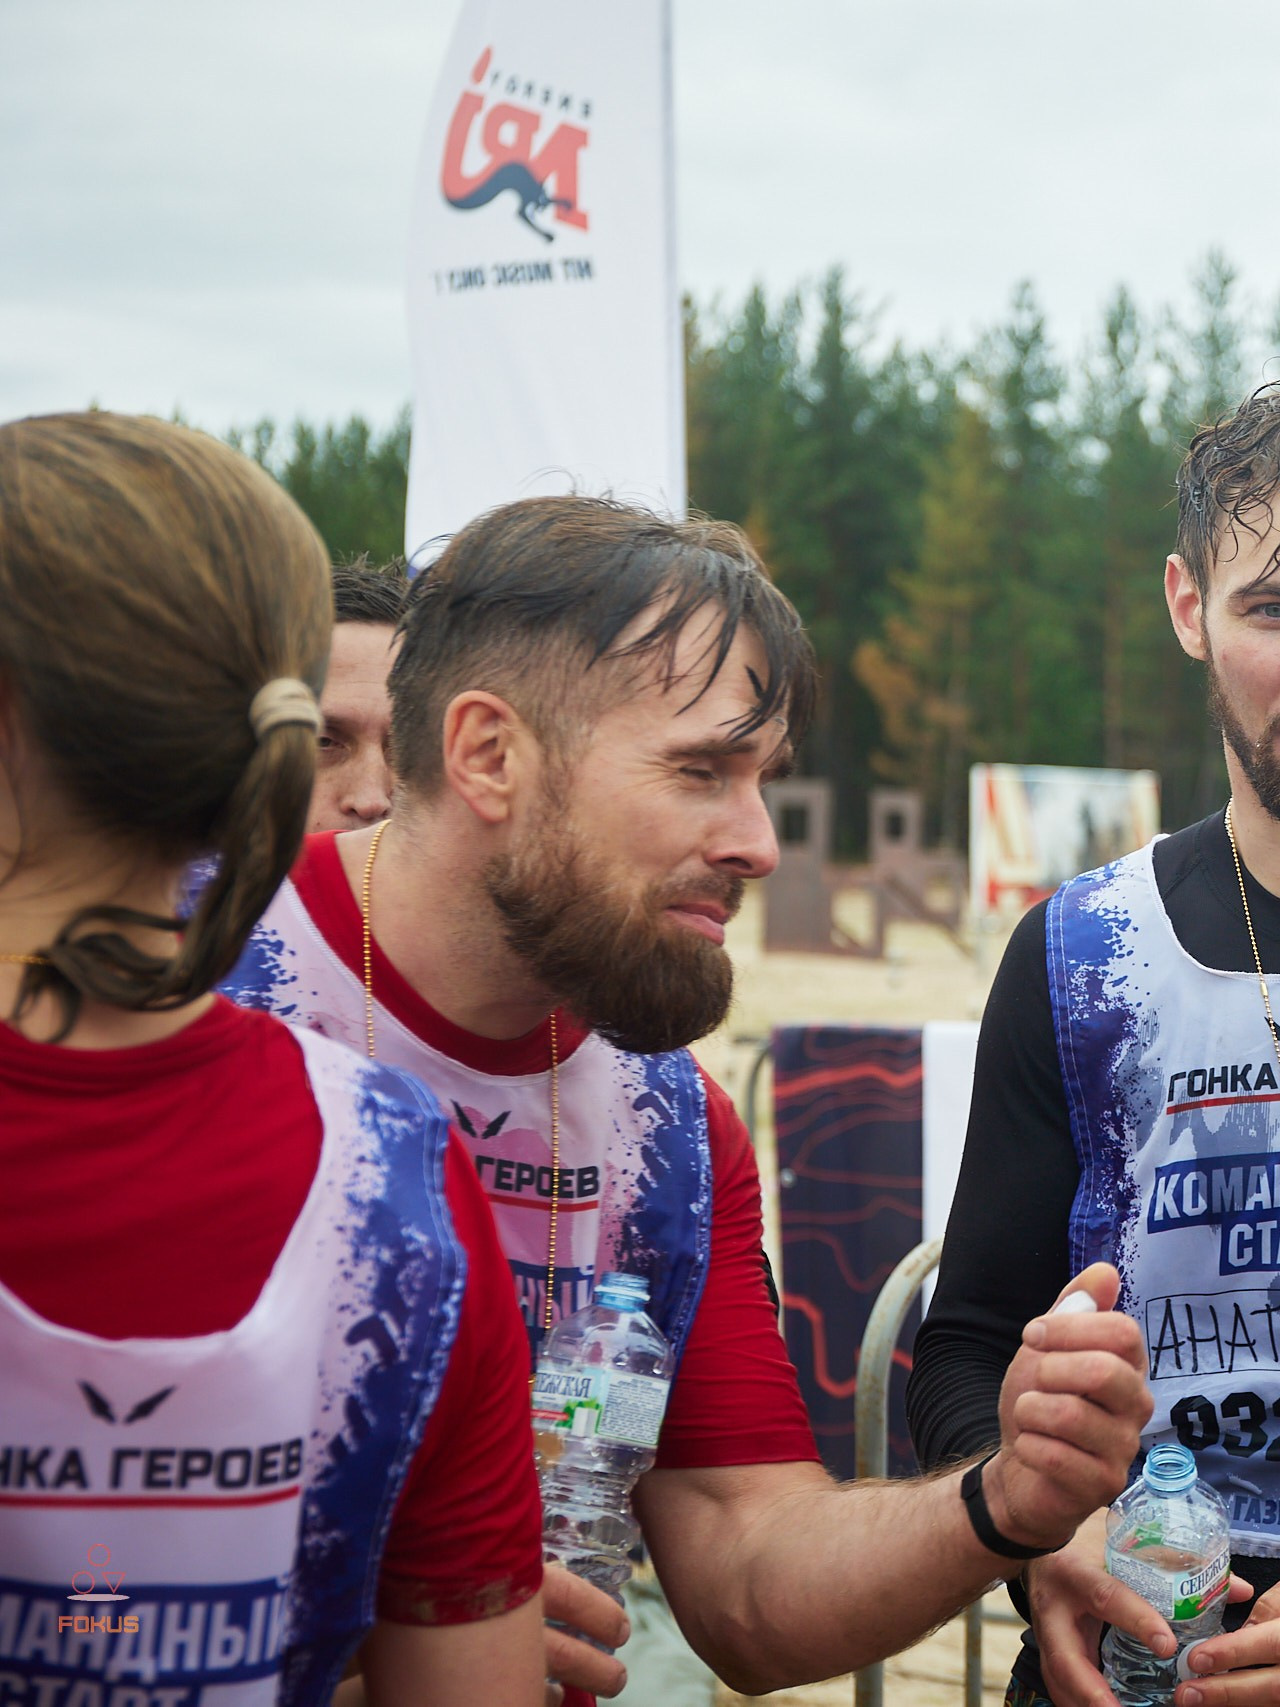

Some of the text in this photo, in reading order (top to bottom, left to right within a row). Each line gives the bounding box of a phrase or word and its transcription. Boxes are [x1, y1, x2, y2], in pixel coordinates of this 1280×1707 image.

[1168, 1062, 1278, 1103] ГОНКА
[475, 1155, 600, 1199] ГЕРОЕВ
[109, 1439, 304, 1490] ГЕРОЕВ
